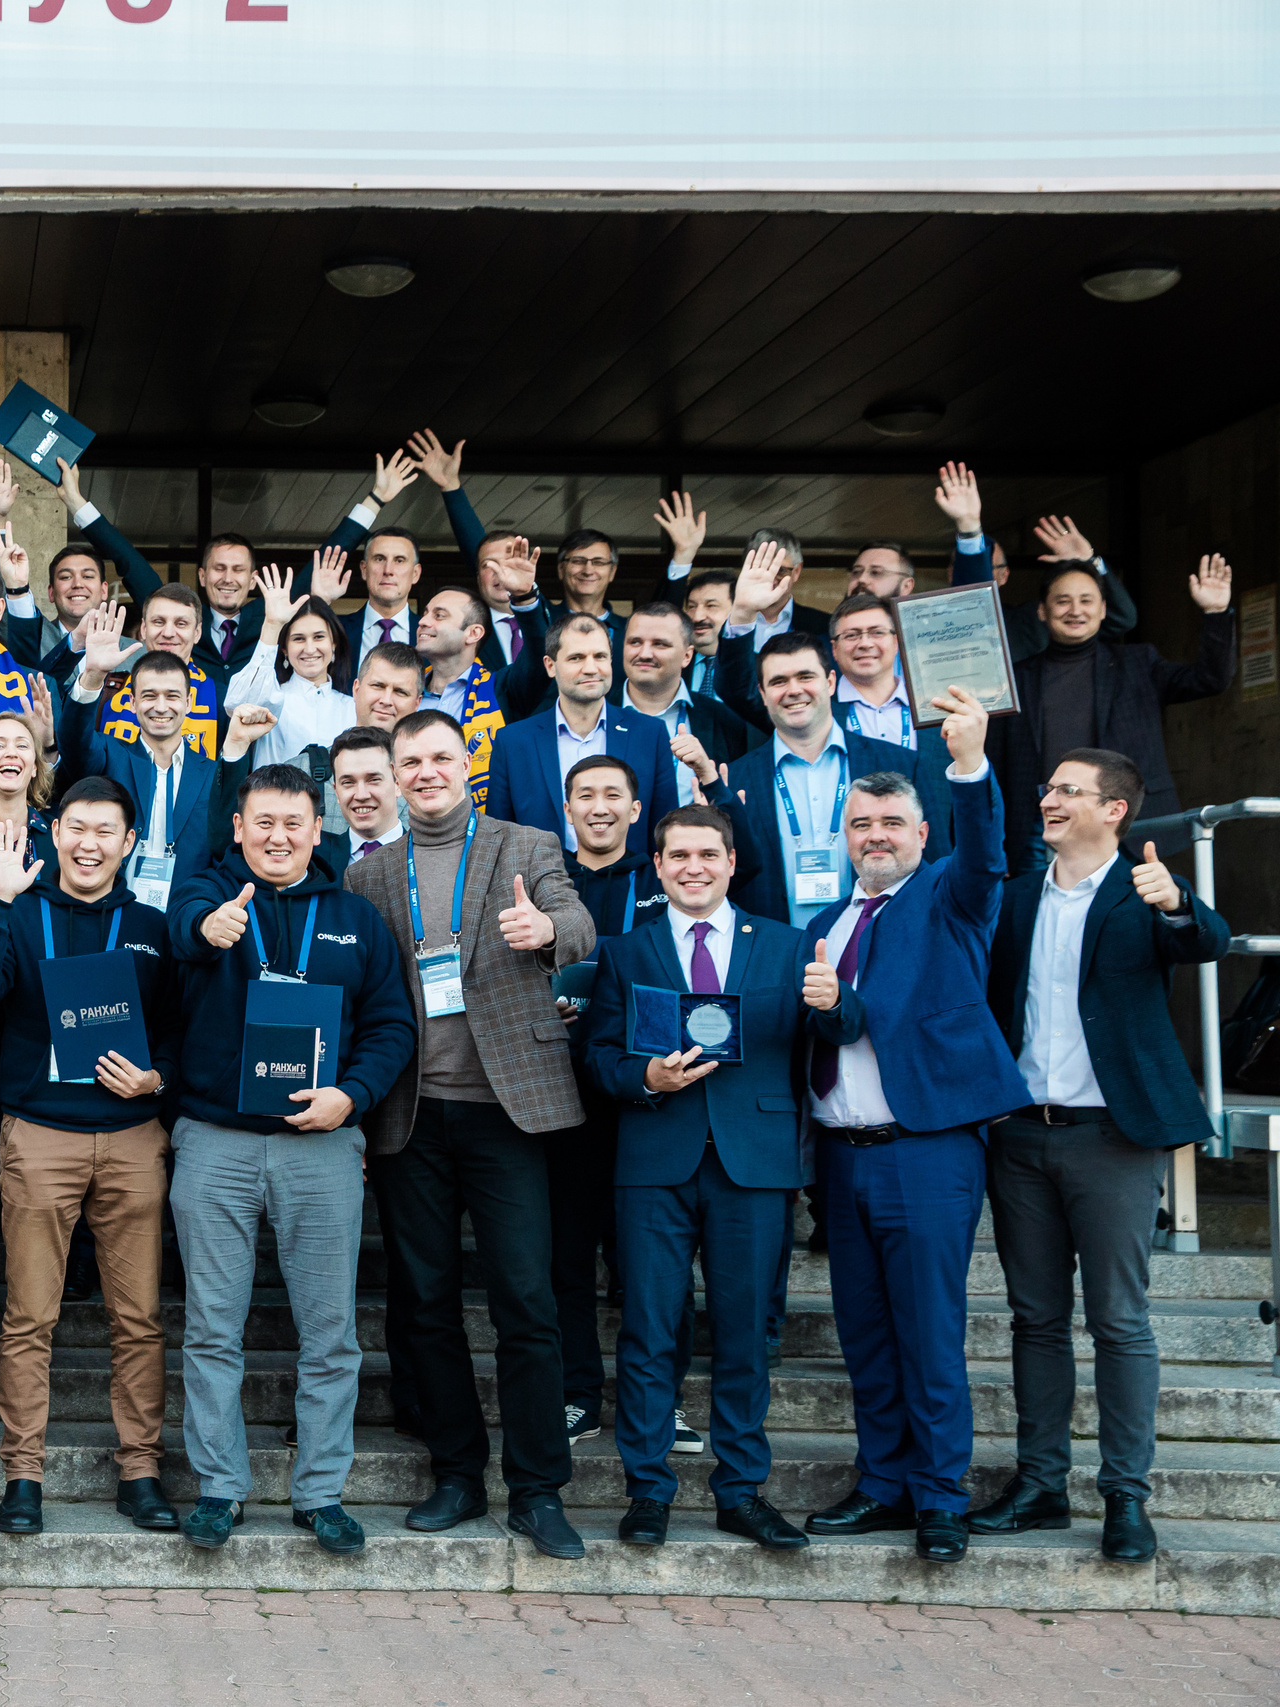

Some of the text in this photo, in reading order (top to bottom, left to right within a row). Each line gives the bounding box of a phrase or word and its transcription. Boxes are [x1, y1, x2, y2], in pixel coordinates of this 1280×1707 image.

[317, 933, 357, 943] ONECLICK
[80, 1002, 130, 1020] РАНХиГС
[270, 1062, 307, 1073] РАНХиГС
